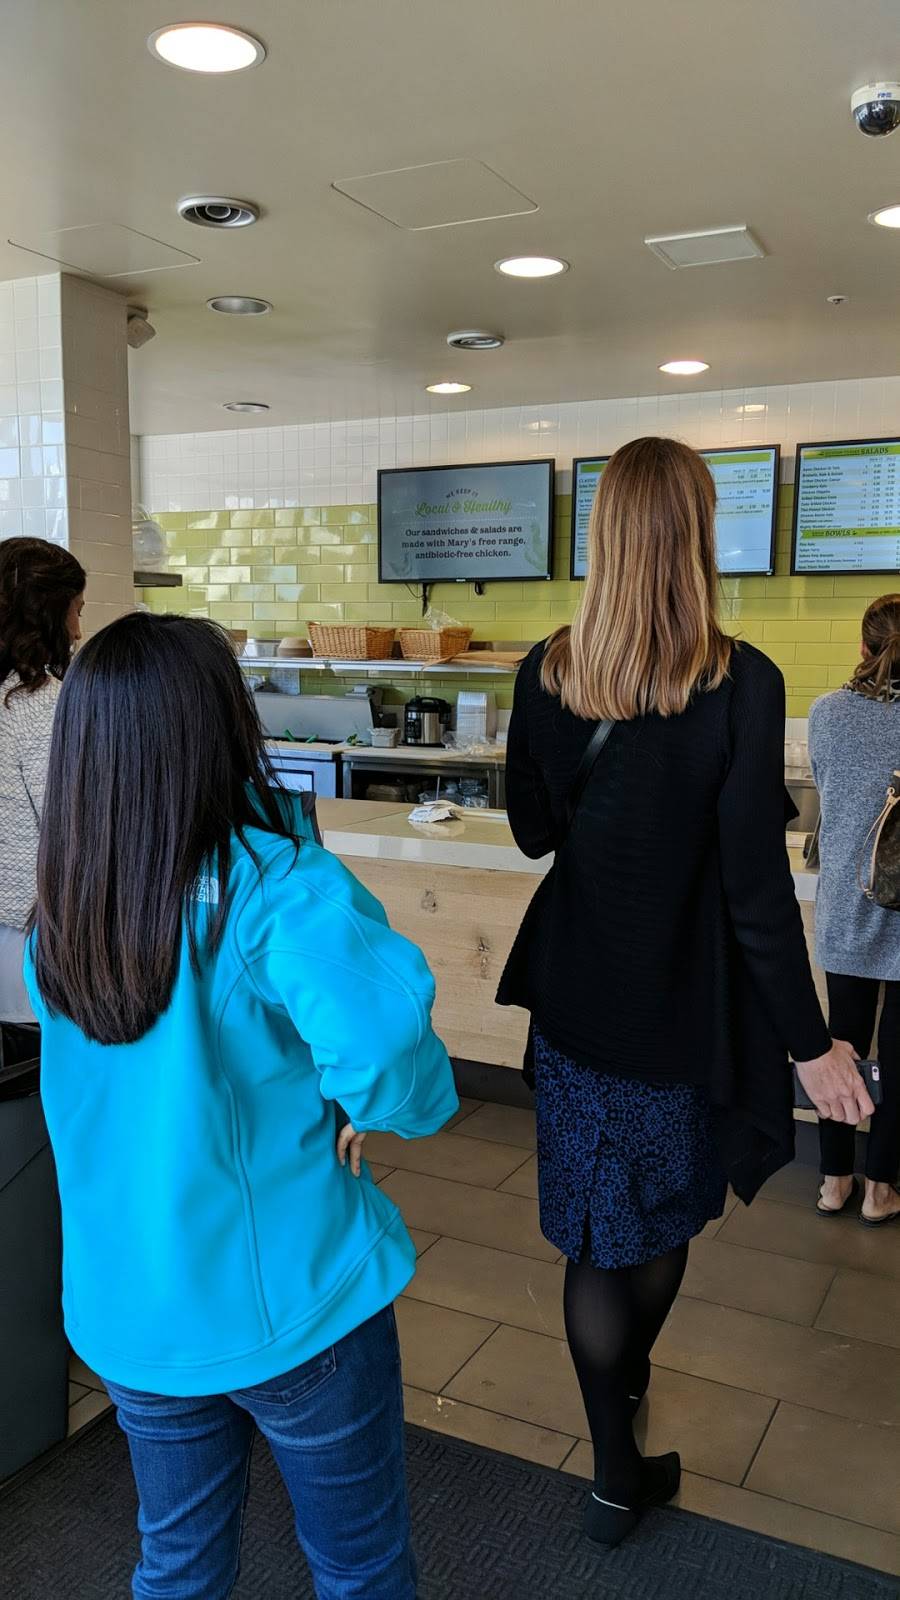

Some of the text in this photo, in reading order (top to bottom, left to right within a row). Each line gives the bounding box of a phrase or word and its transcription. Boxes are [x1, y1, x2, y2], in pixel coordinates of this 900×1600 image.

[861, 447, 889, 455] SALADS
[415, 499, 512, 517] Local & Healthy
[405, 528, 421, 537] Our
[422, 526, 469, 536] sandwiches
[470, 526, 478, 534] &
[479, 525, 507, 534] salads
[402, 537, 526, 549] made with Mary's free range,
[415, 549, 512, 559] antibiotic-free chicken.
